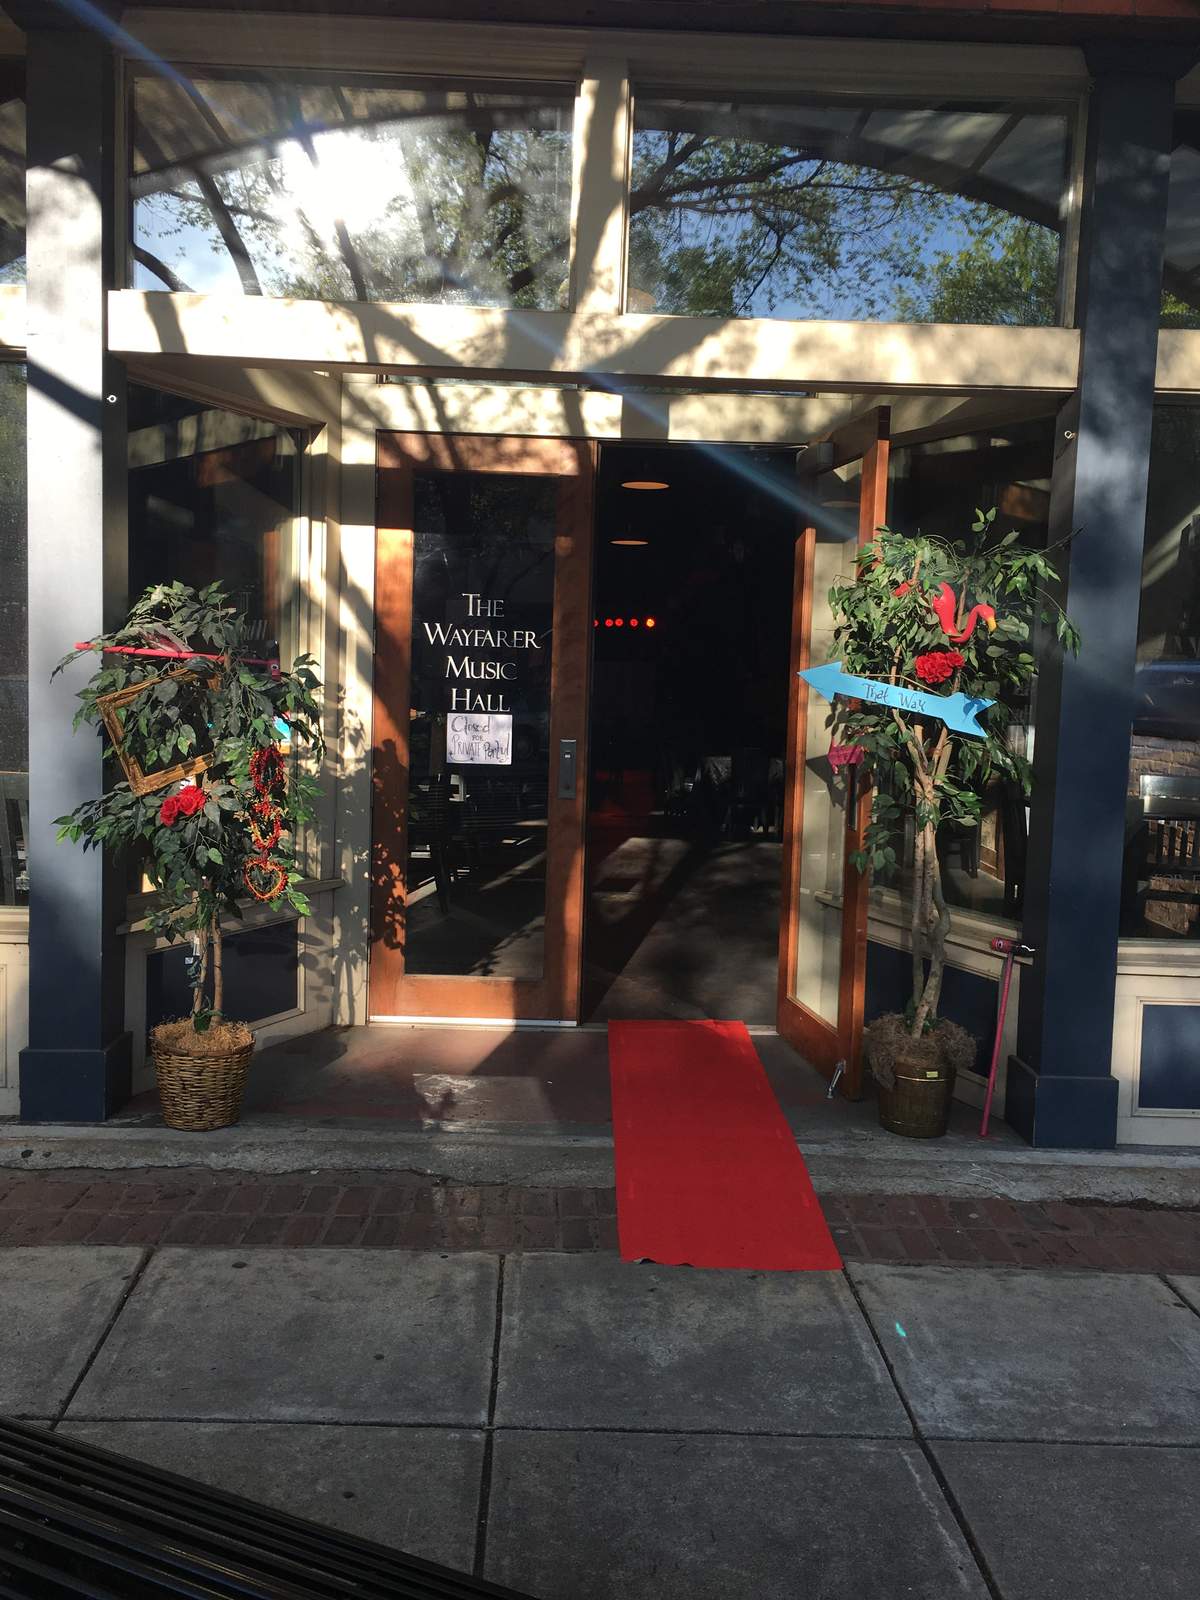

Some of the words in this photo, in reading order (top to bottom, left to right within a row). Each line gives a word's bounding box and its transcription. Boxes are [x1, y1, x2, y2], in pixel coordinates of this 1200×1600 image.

[462, 593, 505, 618] THE
[423, 622, 541, 649] WAYFARER
[445, 655, 518, 680] MUSIC
[451, 688, 510, 712] HALL
[861, 682, 889, 703] That
